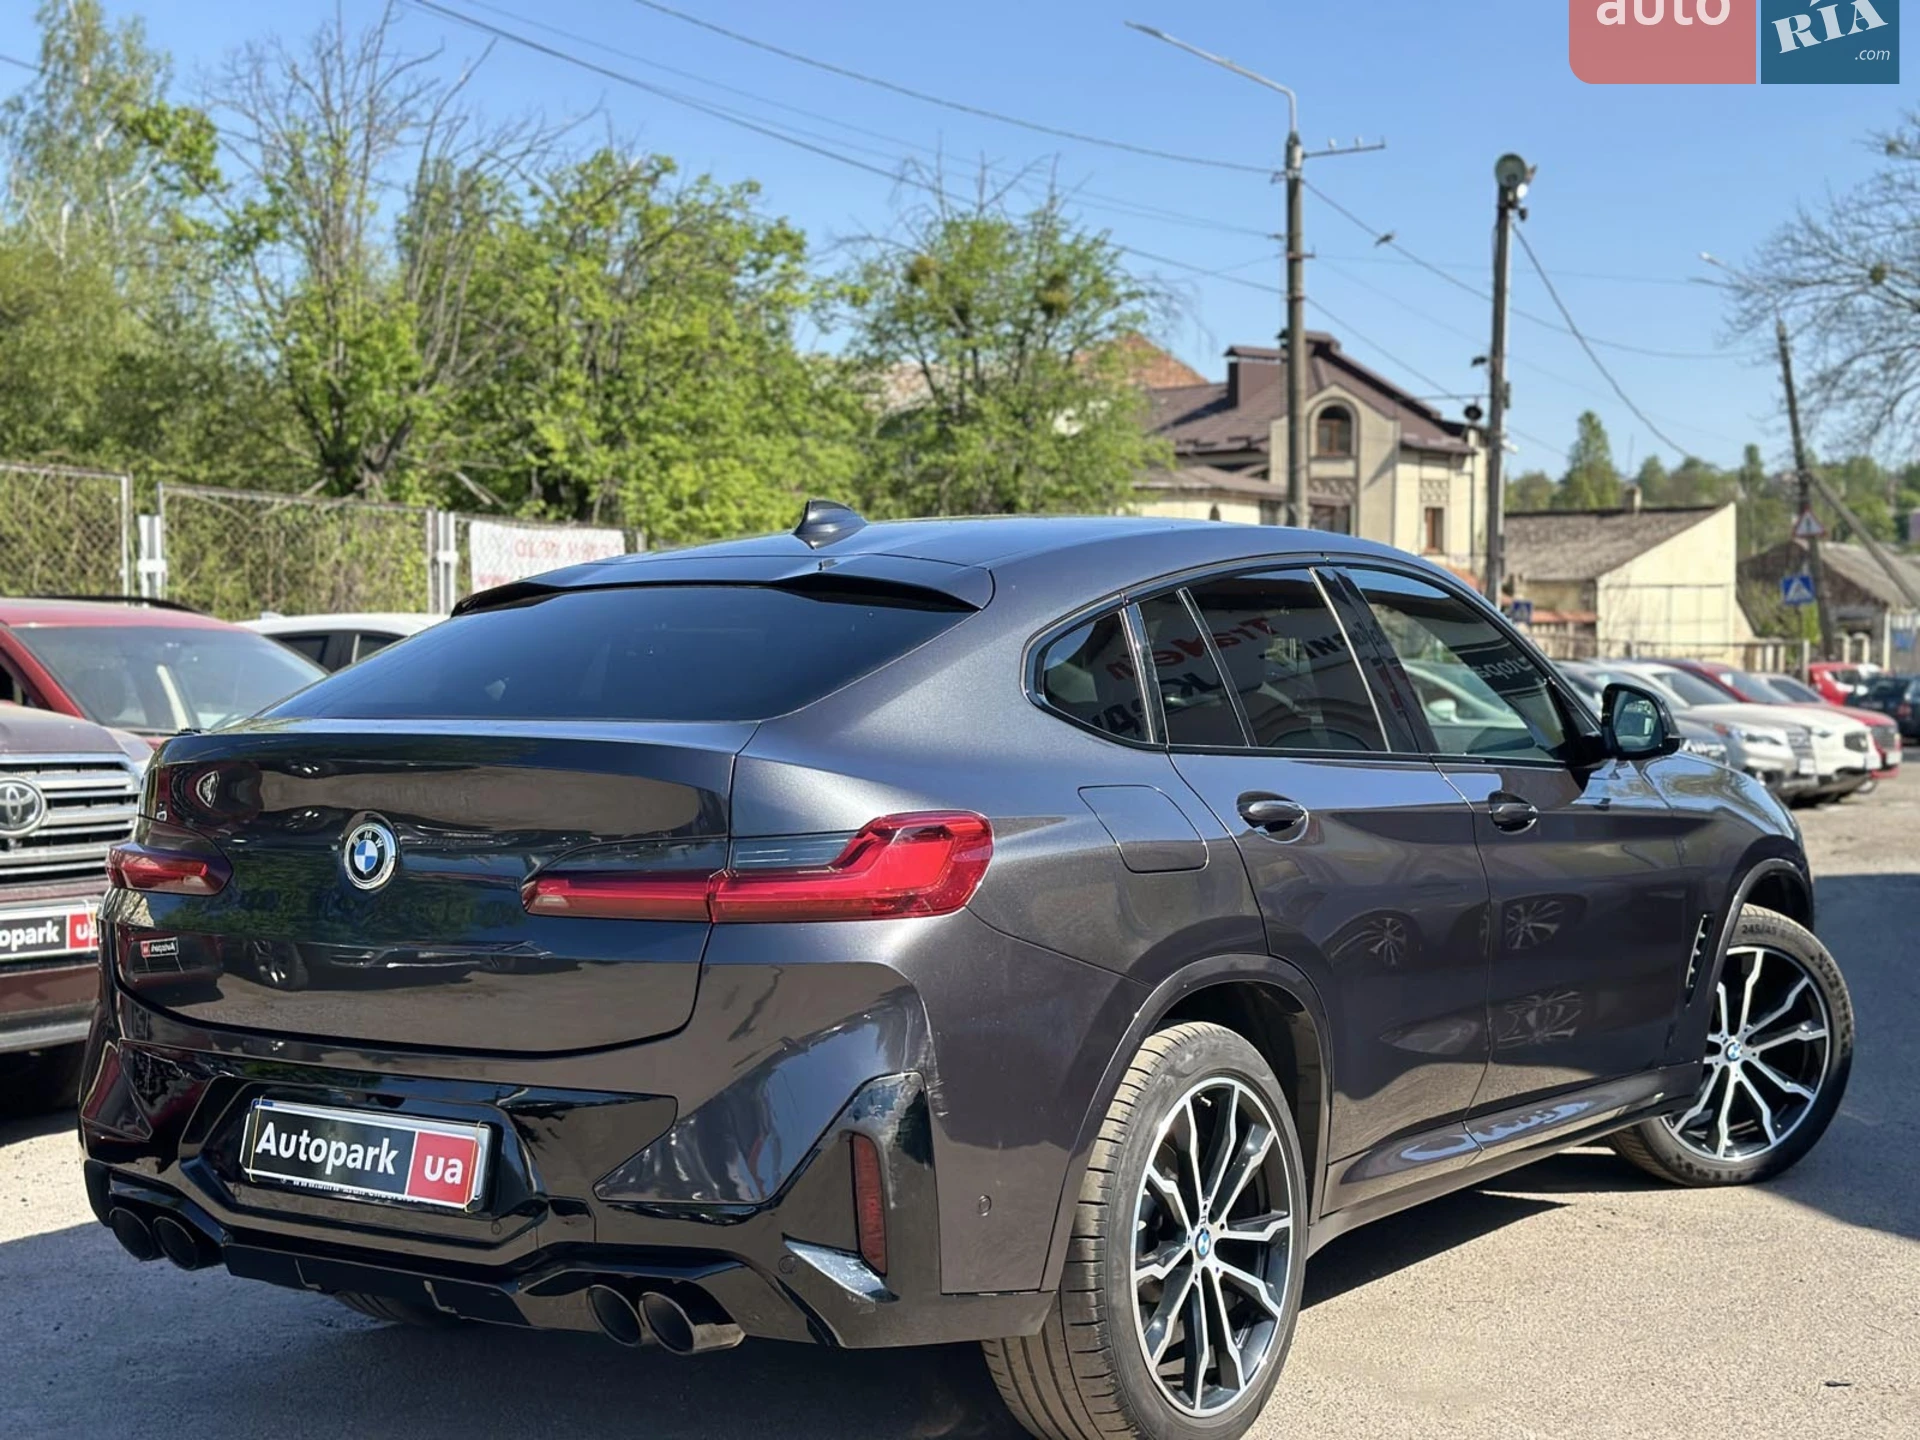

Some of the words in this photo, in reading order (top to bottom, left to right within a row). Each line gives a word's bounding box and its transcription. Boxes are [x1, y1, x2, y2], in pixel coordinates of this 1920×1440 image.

[352, 830, 384, 847] BMW
[256, 1122, 399, 1175] Autopark
[424, 1155, 463, 1185] ua
